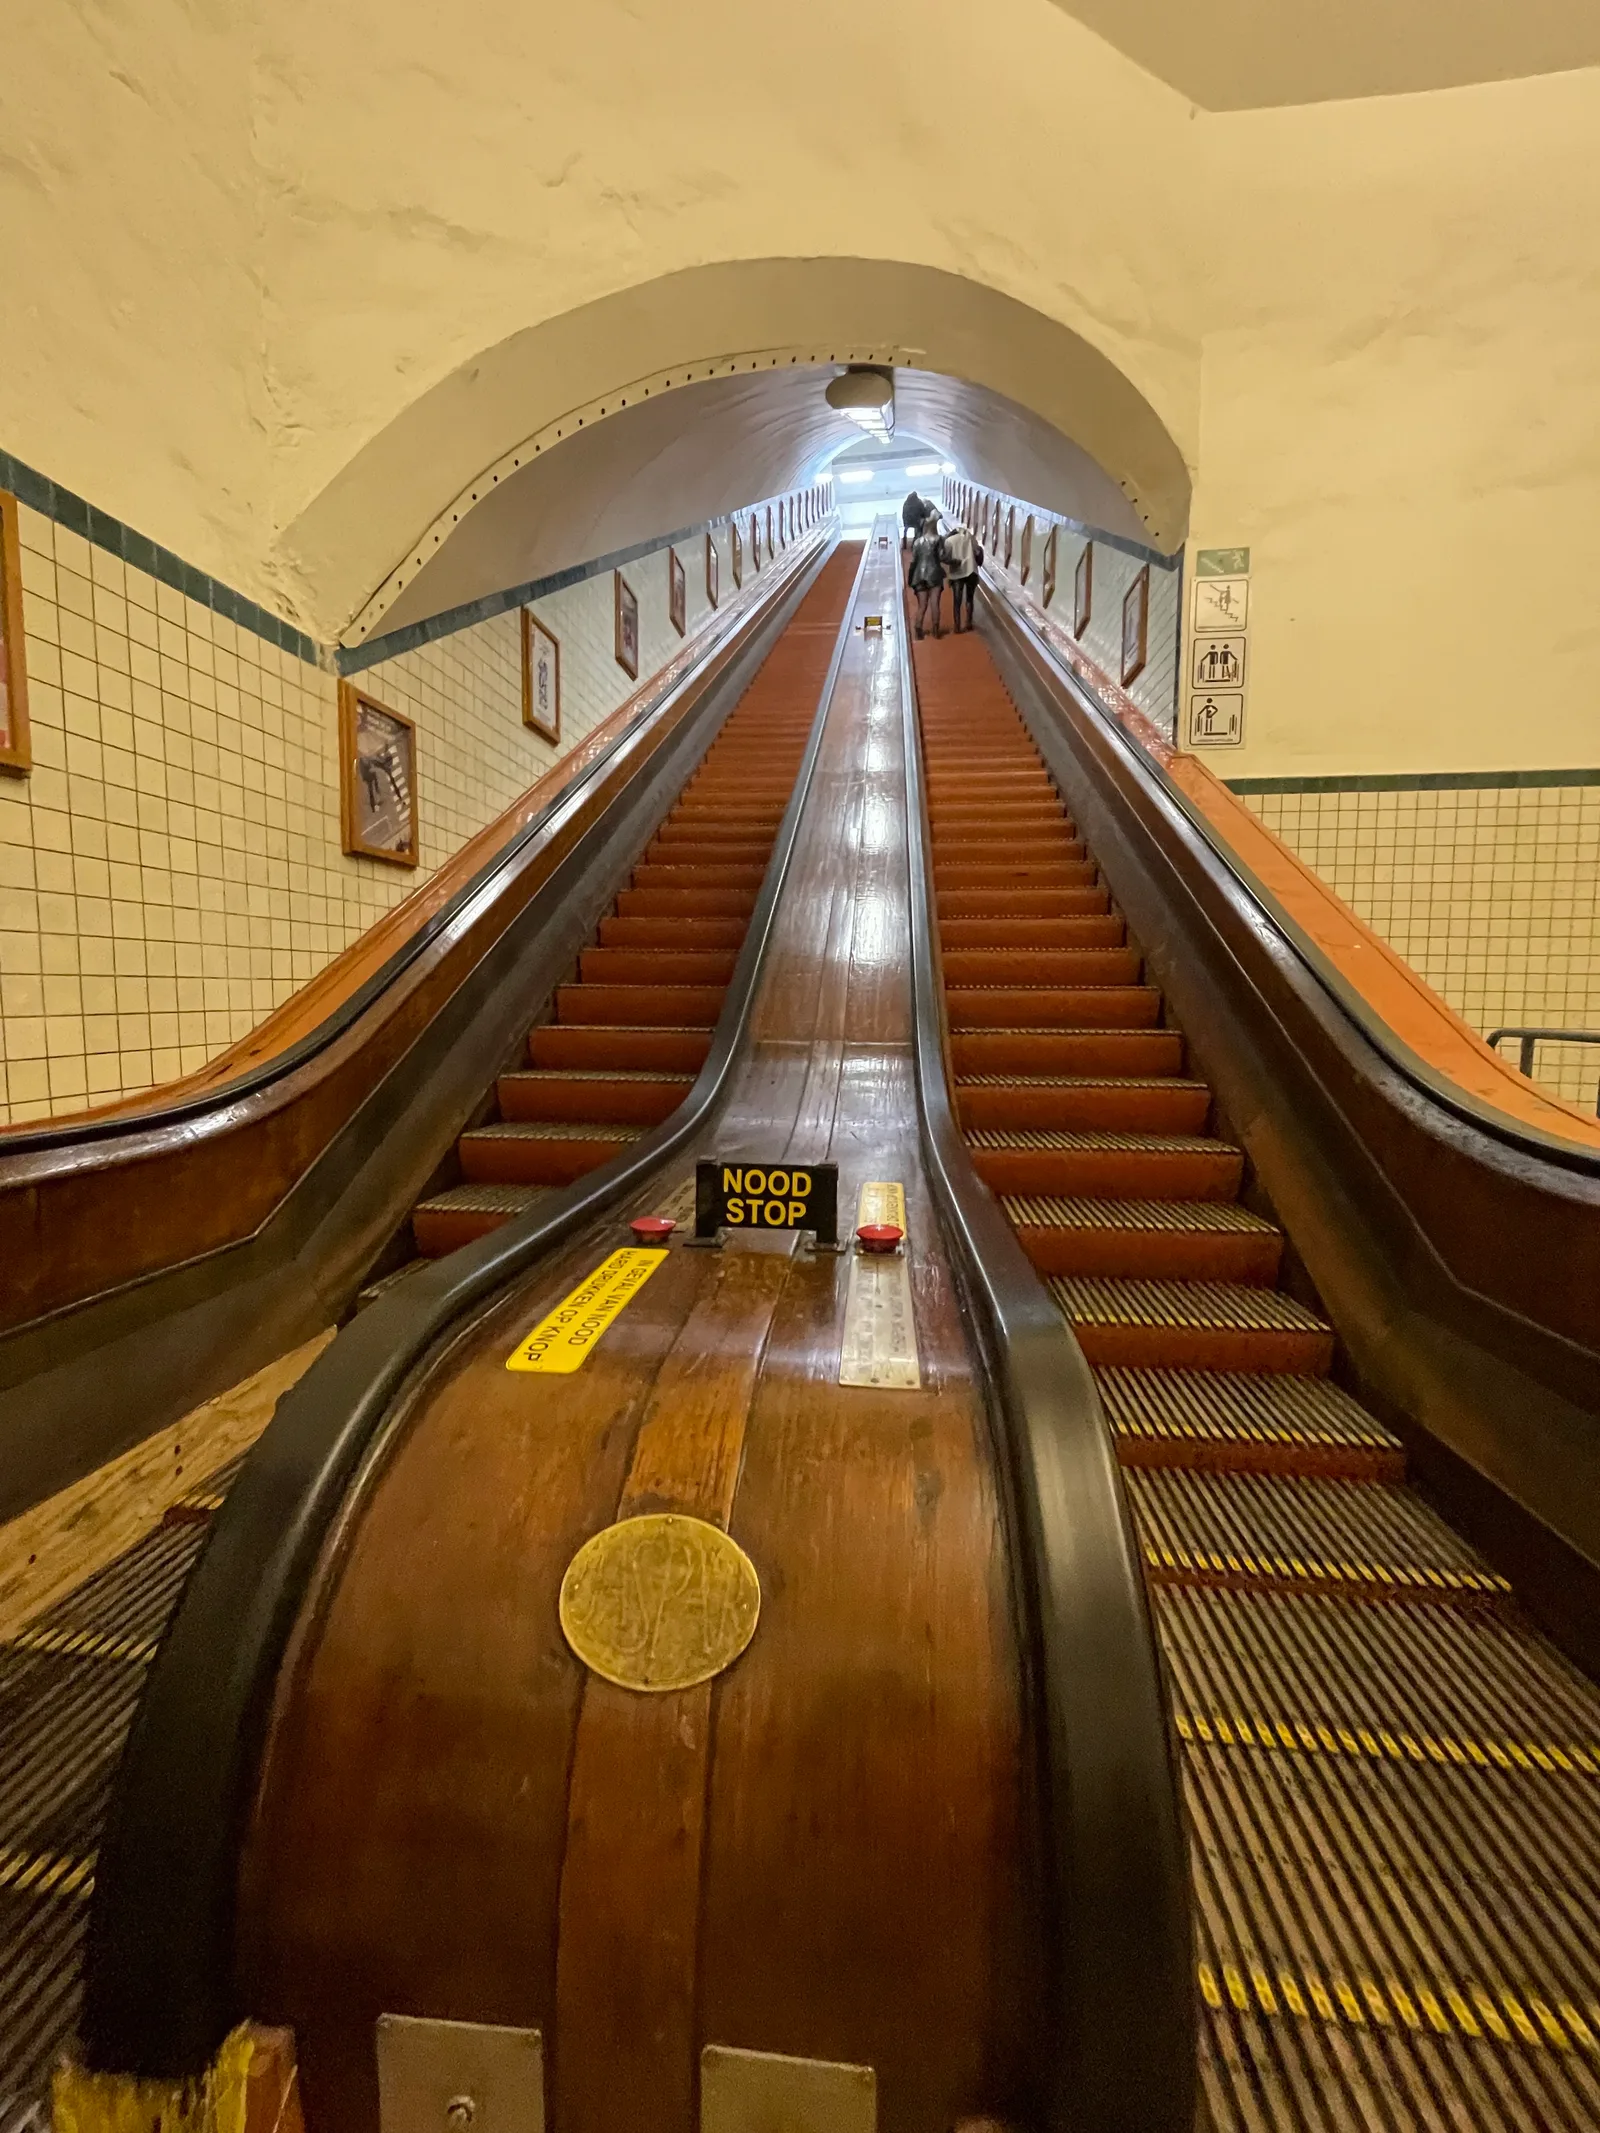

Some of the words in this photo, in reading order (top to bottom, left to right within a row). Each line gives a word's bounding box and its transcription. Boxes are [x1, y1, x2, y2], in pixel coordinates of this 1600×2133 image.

[723, 1167, 812, 1198] NOOD
[726, 1197, 807, 1226] STOP
[612, 1268, 647, 1292] GEVAL
[555, 1309, 578, 1323] OP
[595, 1294, 626, 1311] VAN
[523, 1326, 565, 1361] KNOP
[568, 1313, 607, 1346] NOOD
